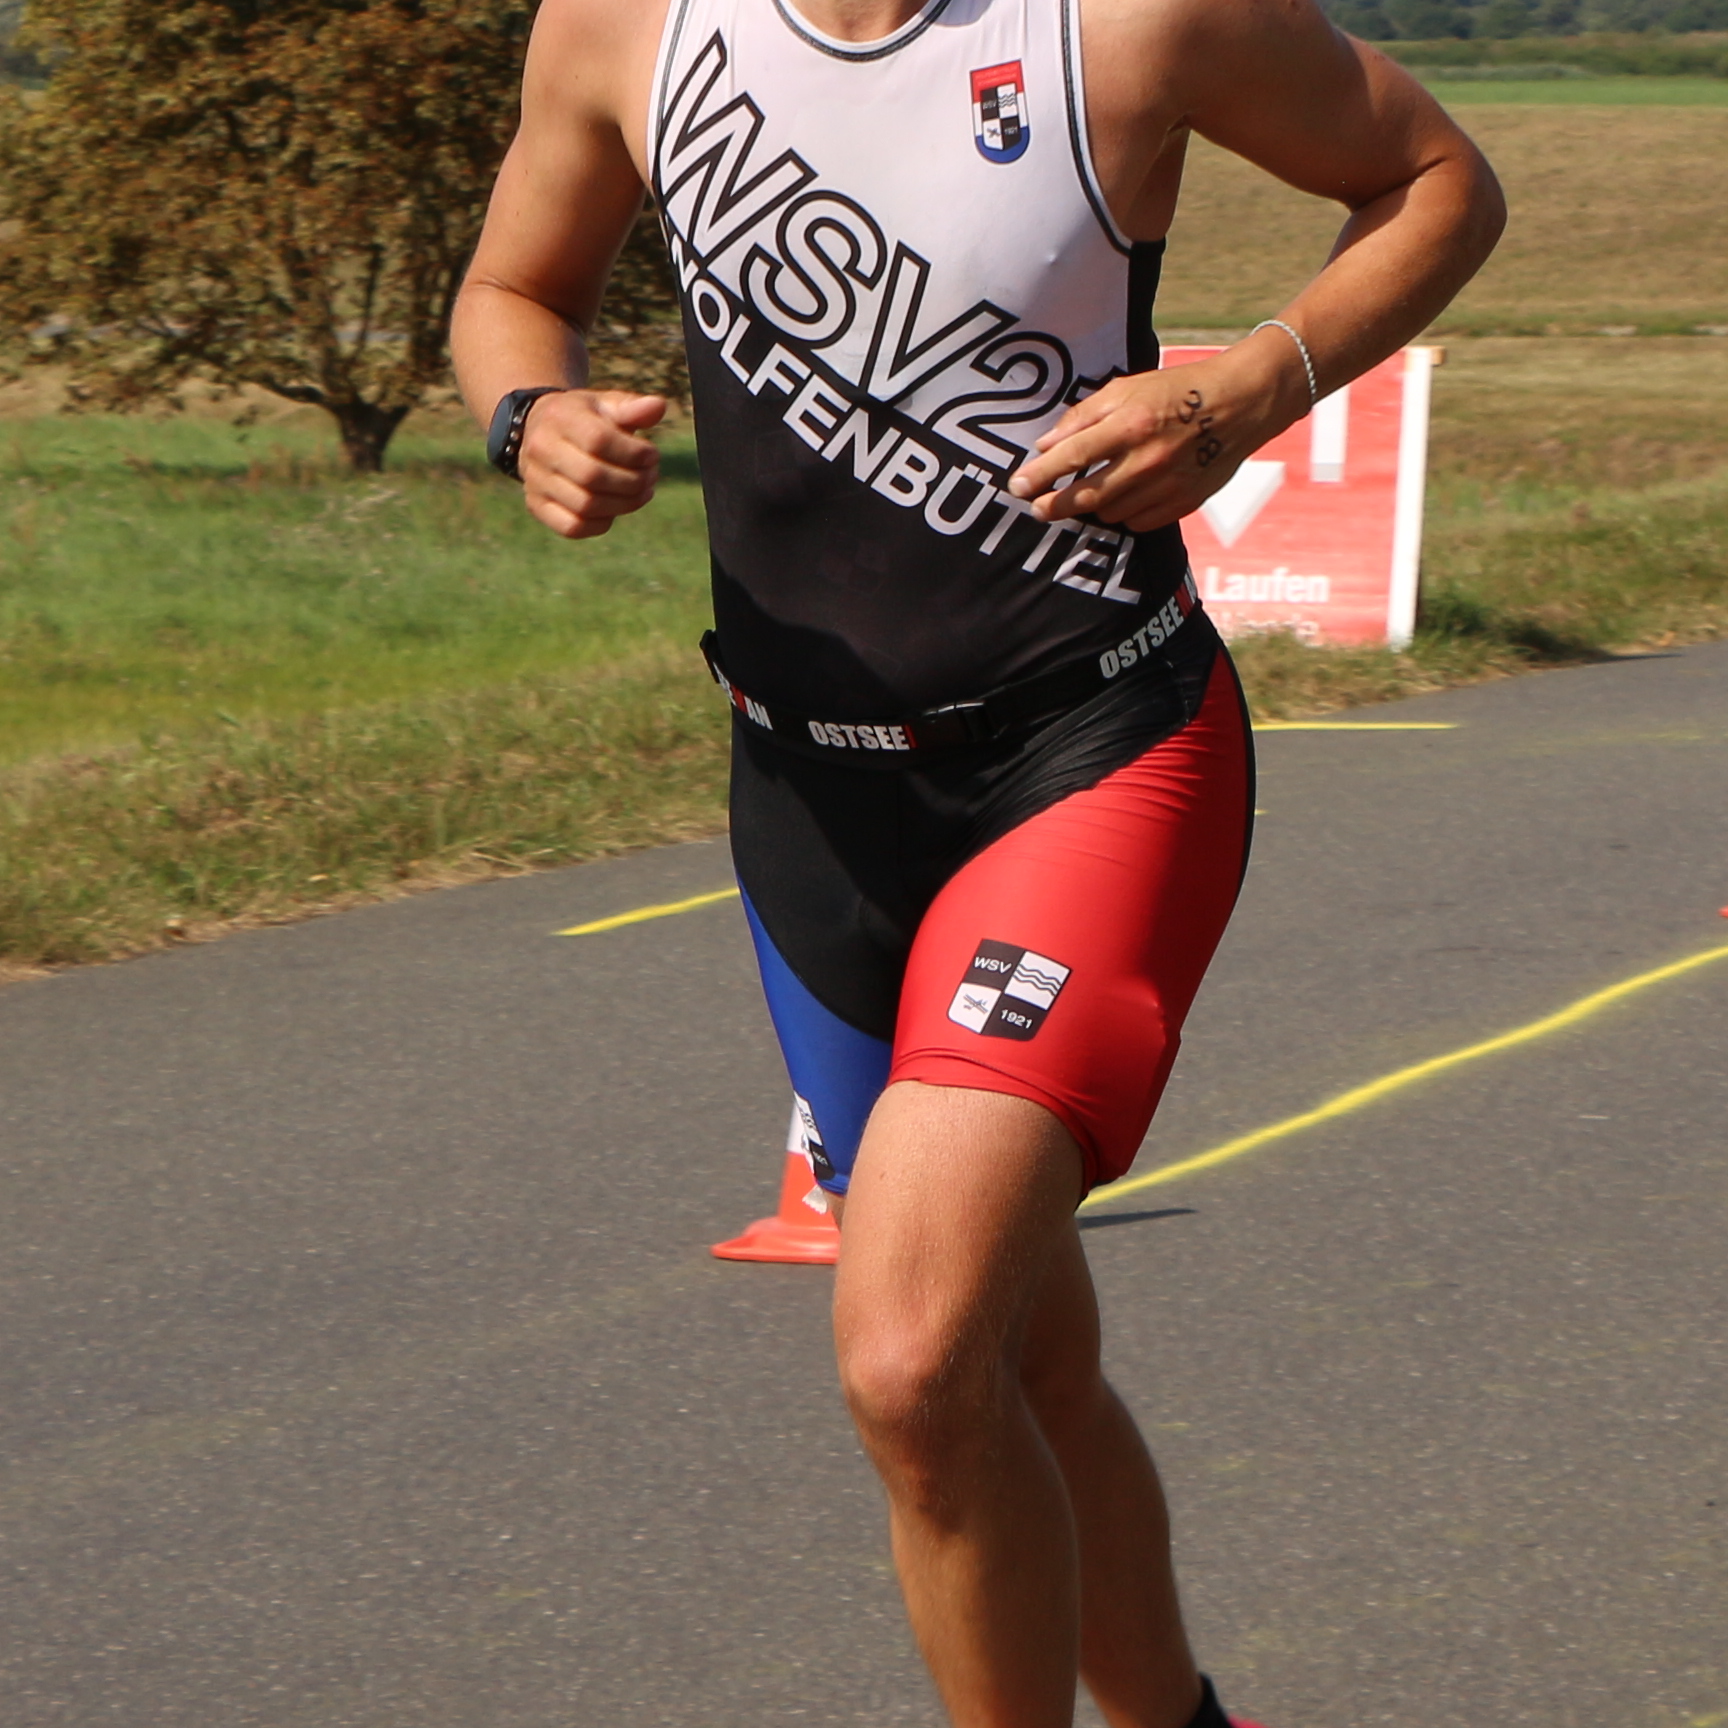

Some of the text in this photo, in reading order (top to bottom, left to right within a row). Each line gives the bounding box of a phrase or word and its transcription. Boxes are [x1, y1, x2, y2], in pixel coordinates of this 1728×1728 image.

[658, 26, 1129, 487] WSV2
[1176, 390, 1224, 468] 348
[1205, 566, 1330, 603] Laufen
[974, 956, 1012, 974] WSV
[1001, 1009, 1033, 1029] 1921
